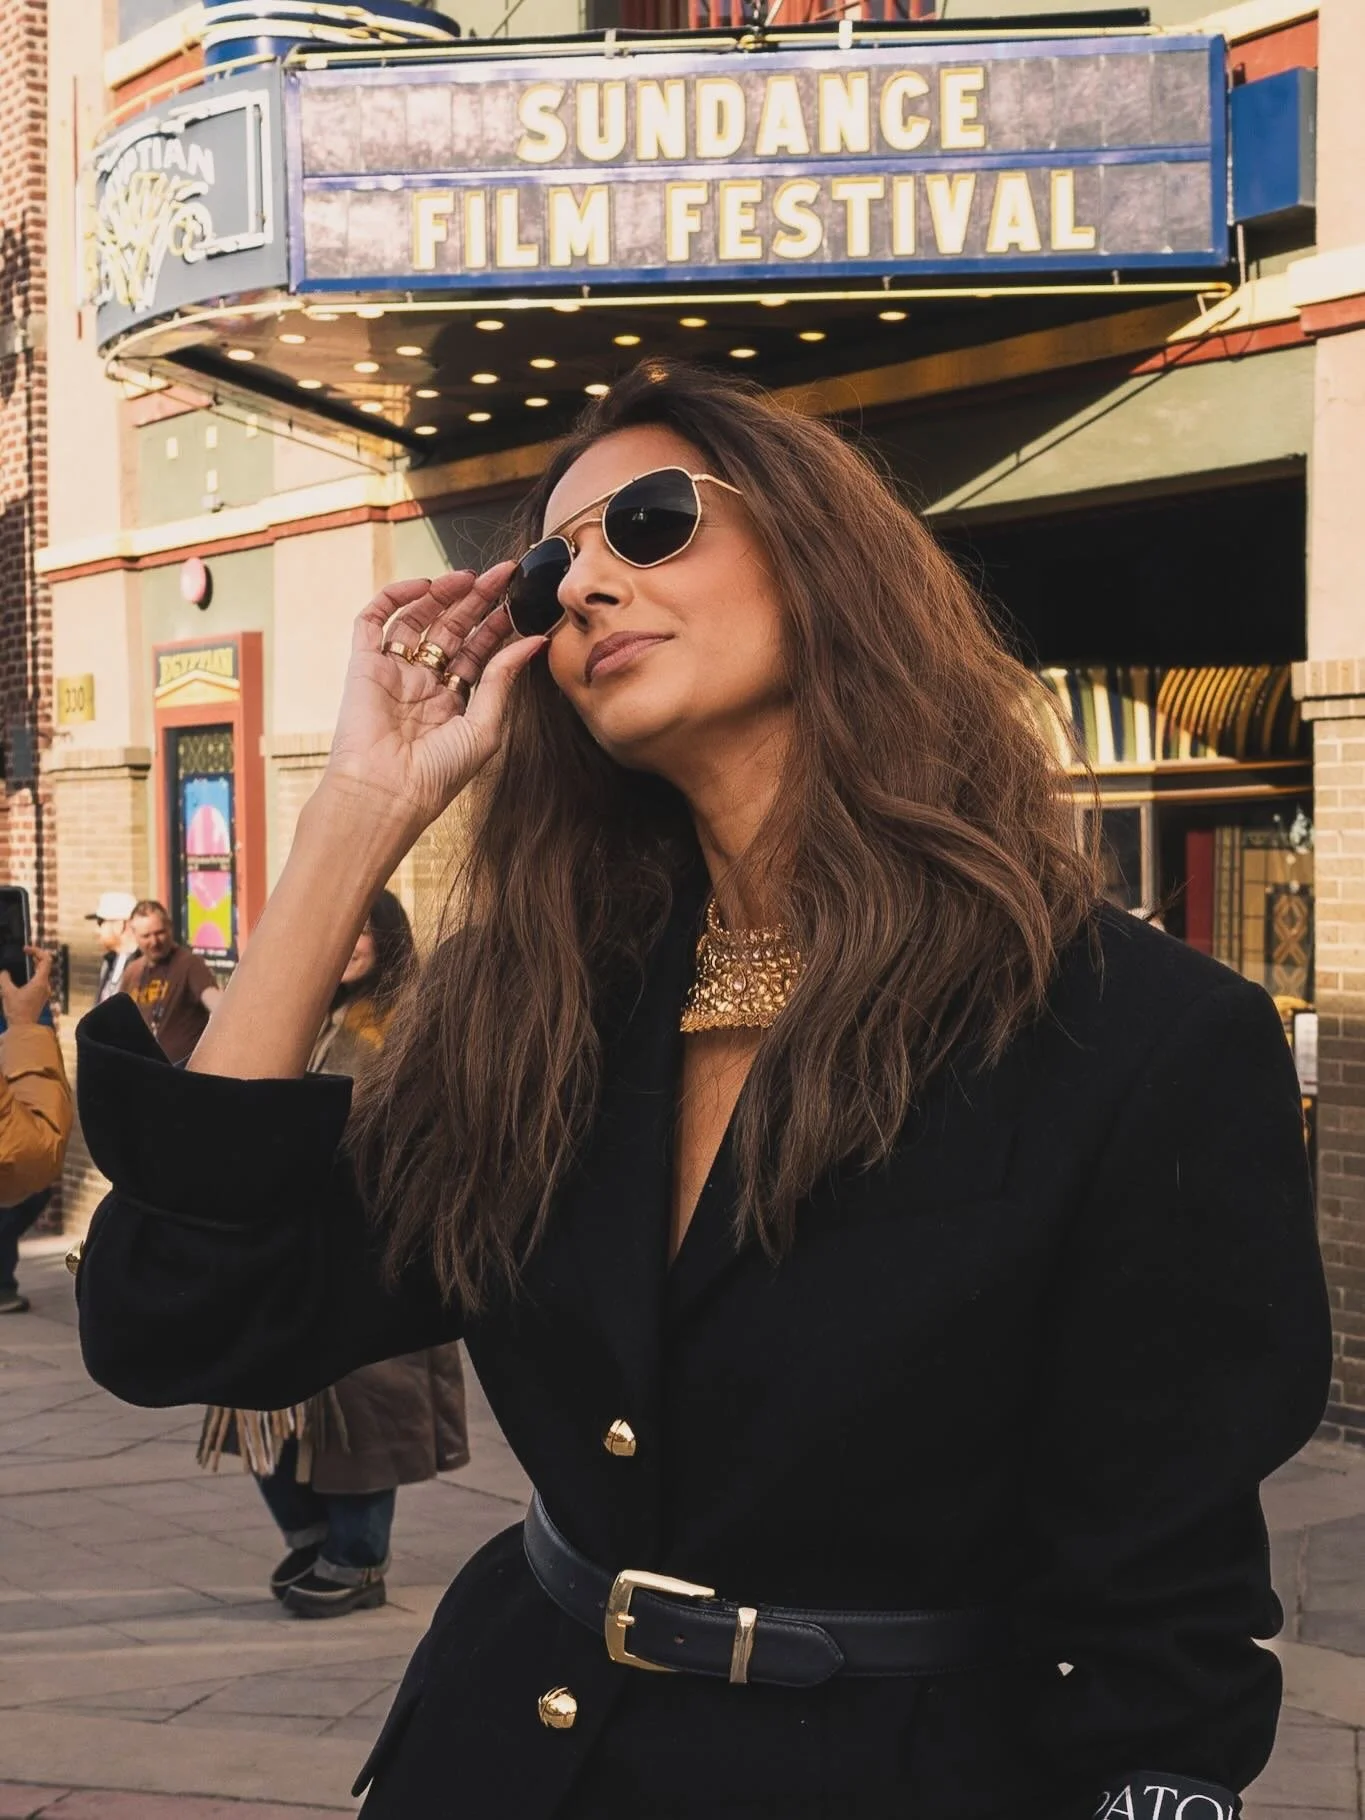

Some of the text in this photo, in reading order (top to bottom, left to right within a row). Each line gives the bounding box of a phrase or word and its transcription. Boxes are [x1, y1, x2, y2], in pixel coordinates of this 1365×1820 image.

[516, 66, 986, 164] SUNDANCE
[413, 168, 1097, 271] FILM FESTIVAL
